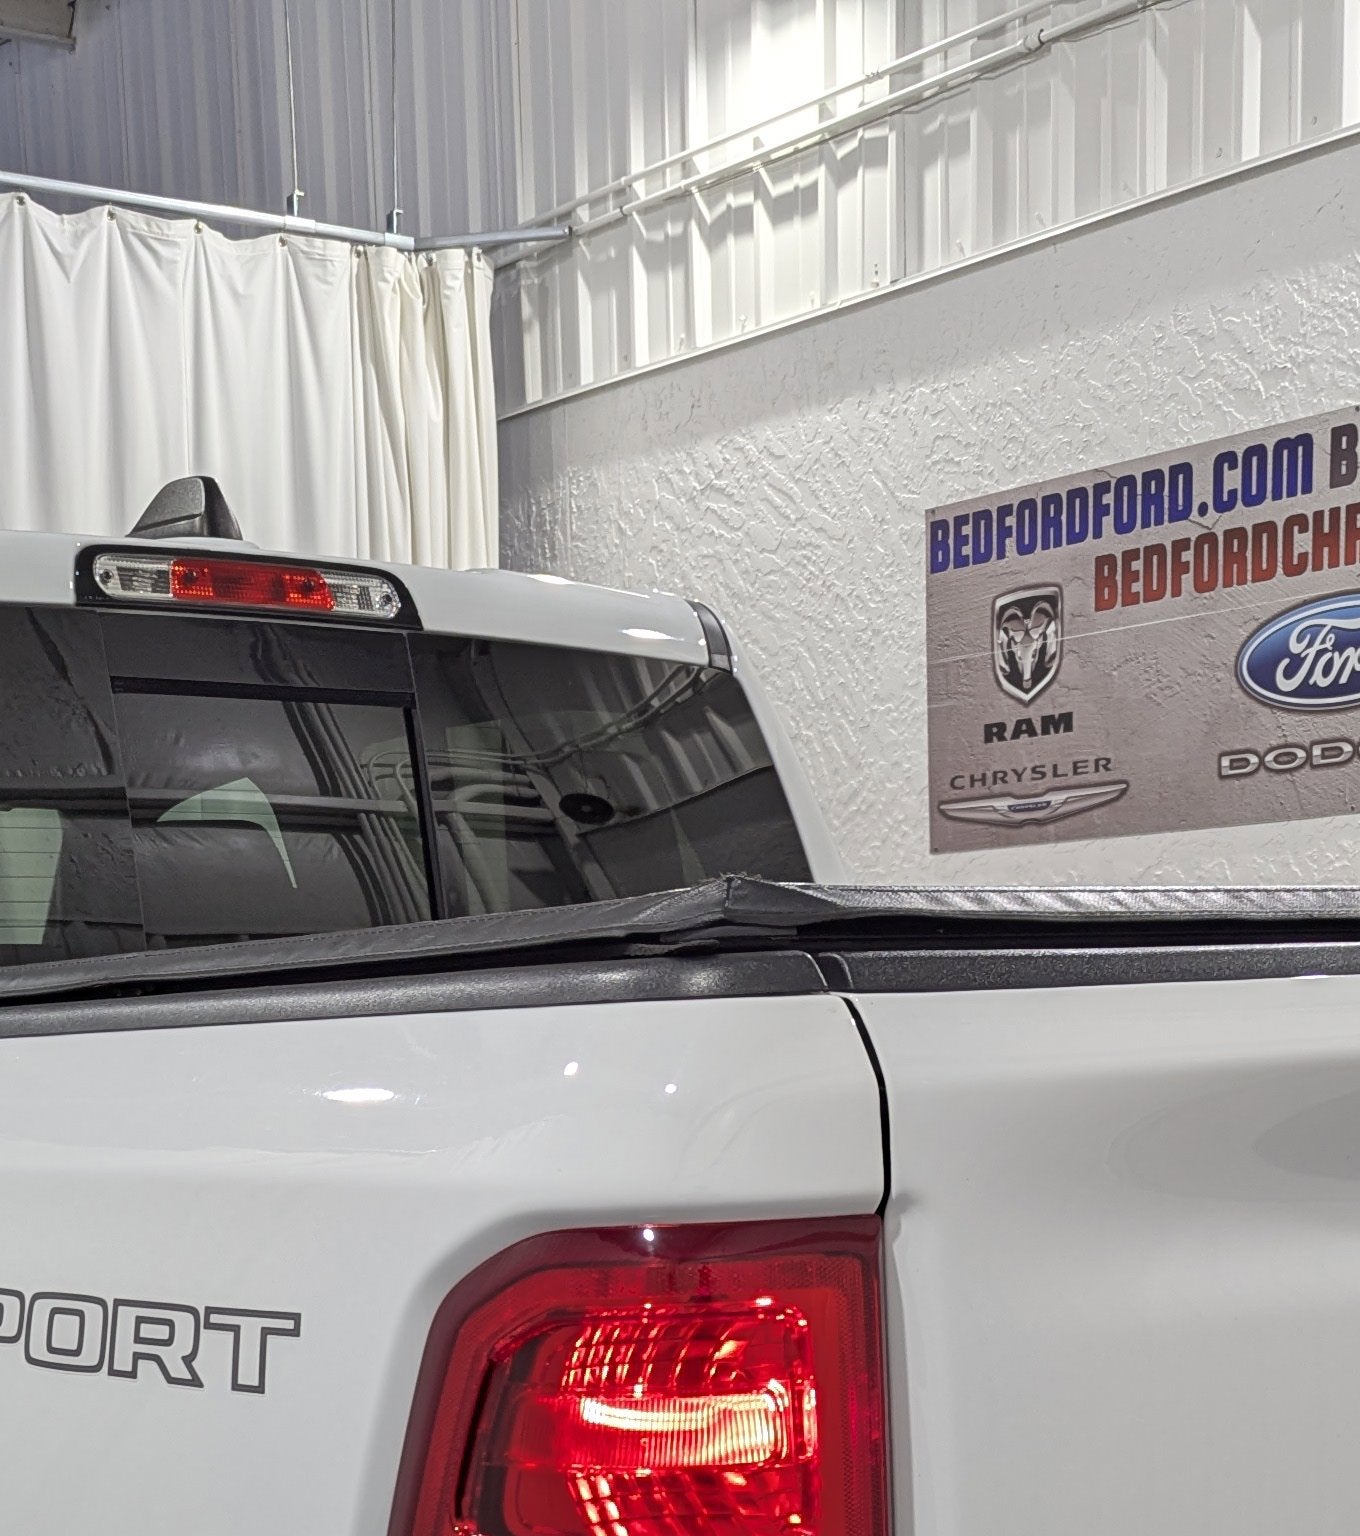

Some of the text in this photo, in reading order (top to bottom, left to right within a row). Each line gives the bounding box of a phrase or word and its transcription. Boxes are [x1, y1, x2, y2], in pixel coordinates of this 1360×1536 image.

[930, 432, 1313, 574] BEDFORDFORD.COM
[983, 711, 1074, 744] RAM
[950, 757, 1113, 791] CHRYSLER
